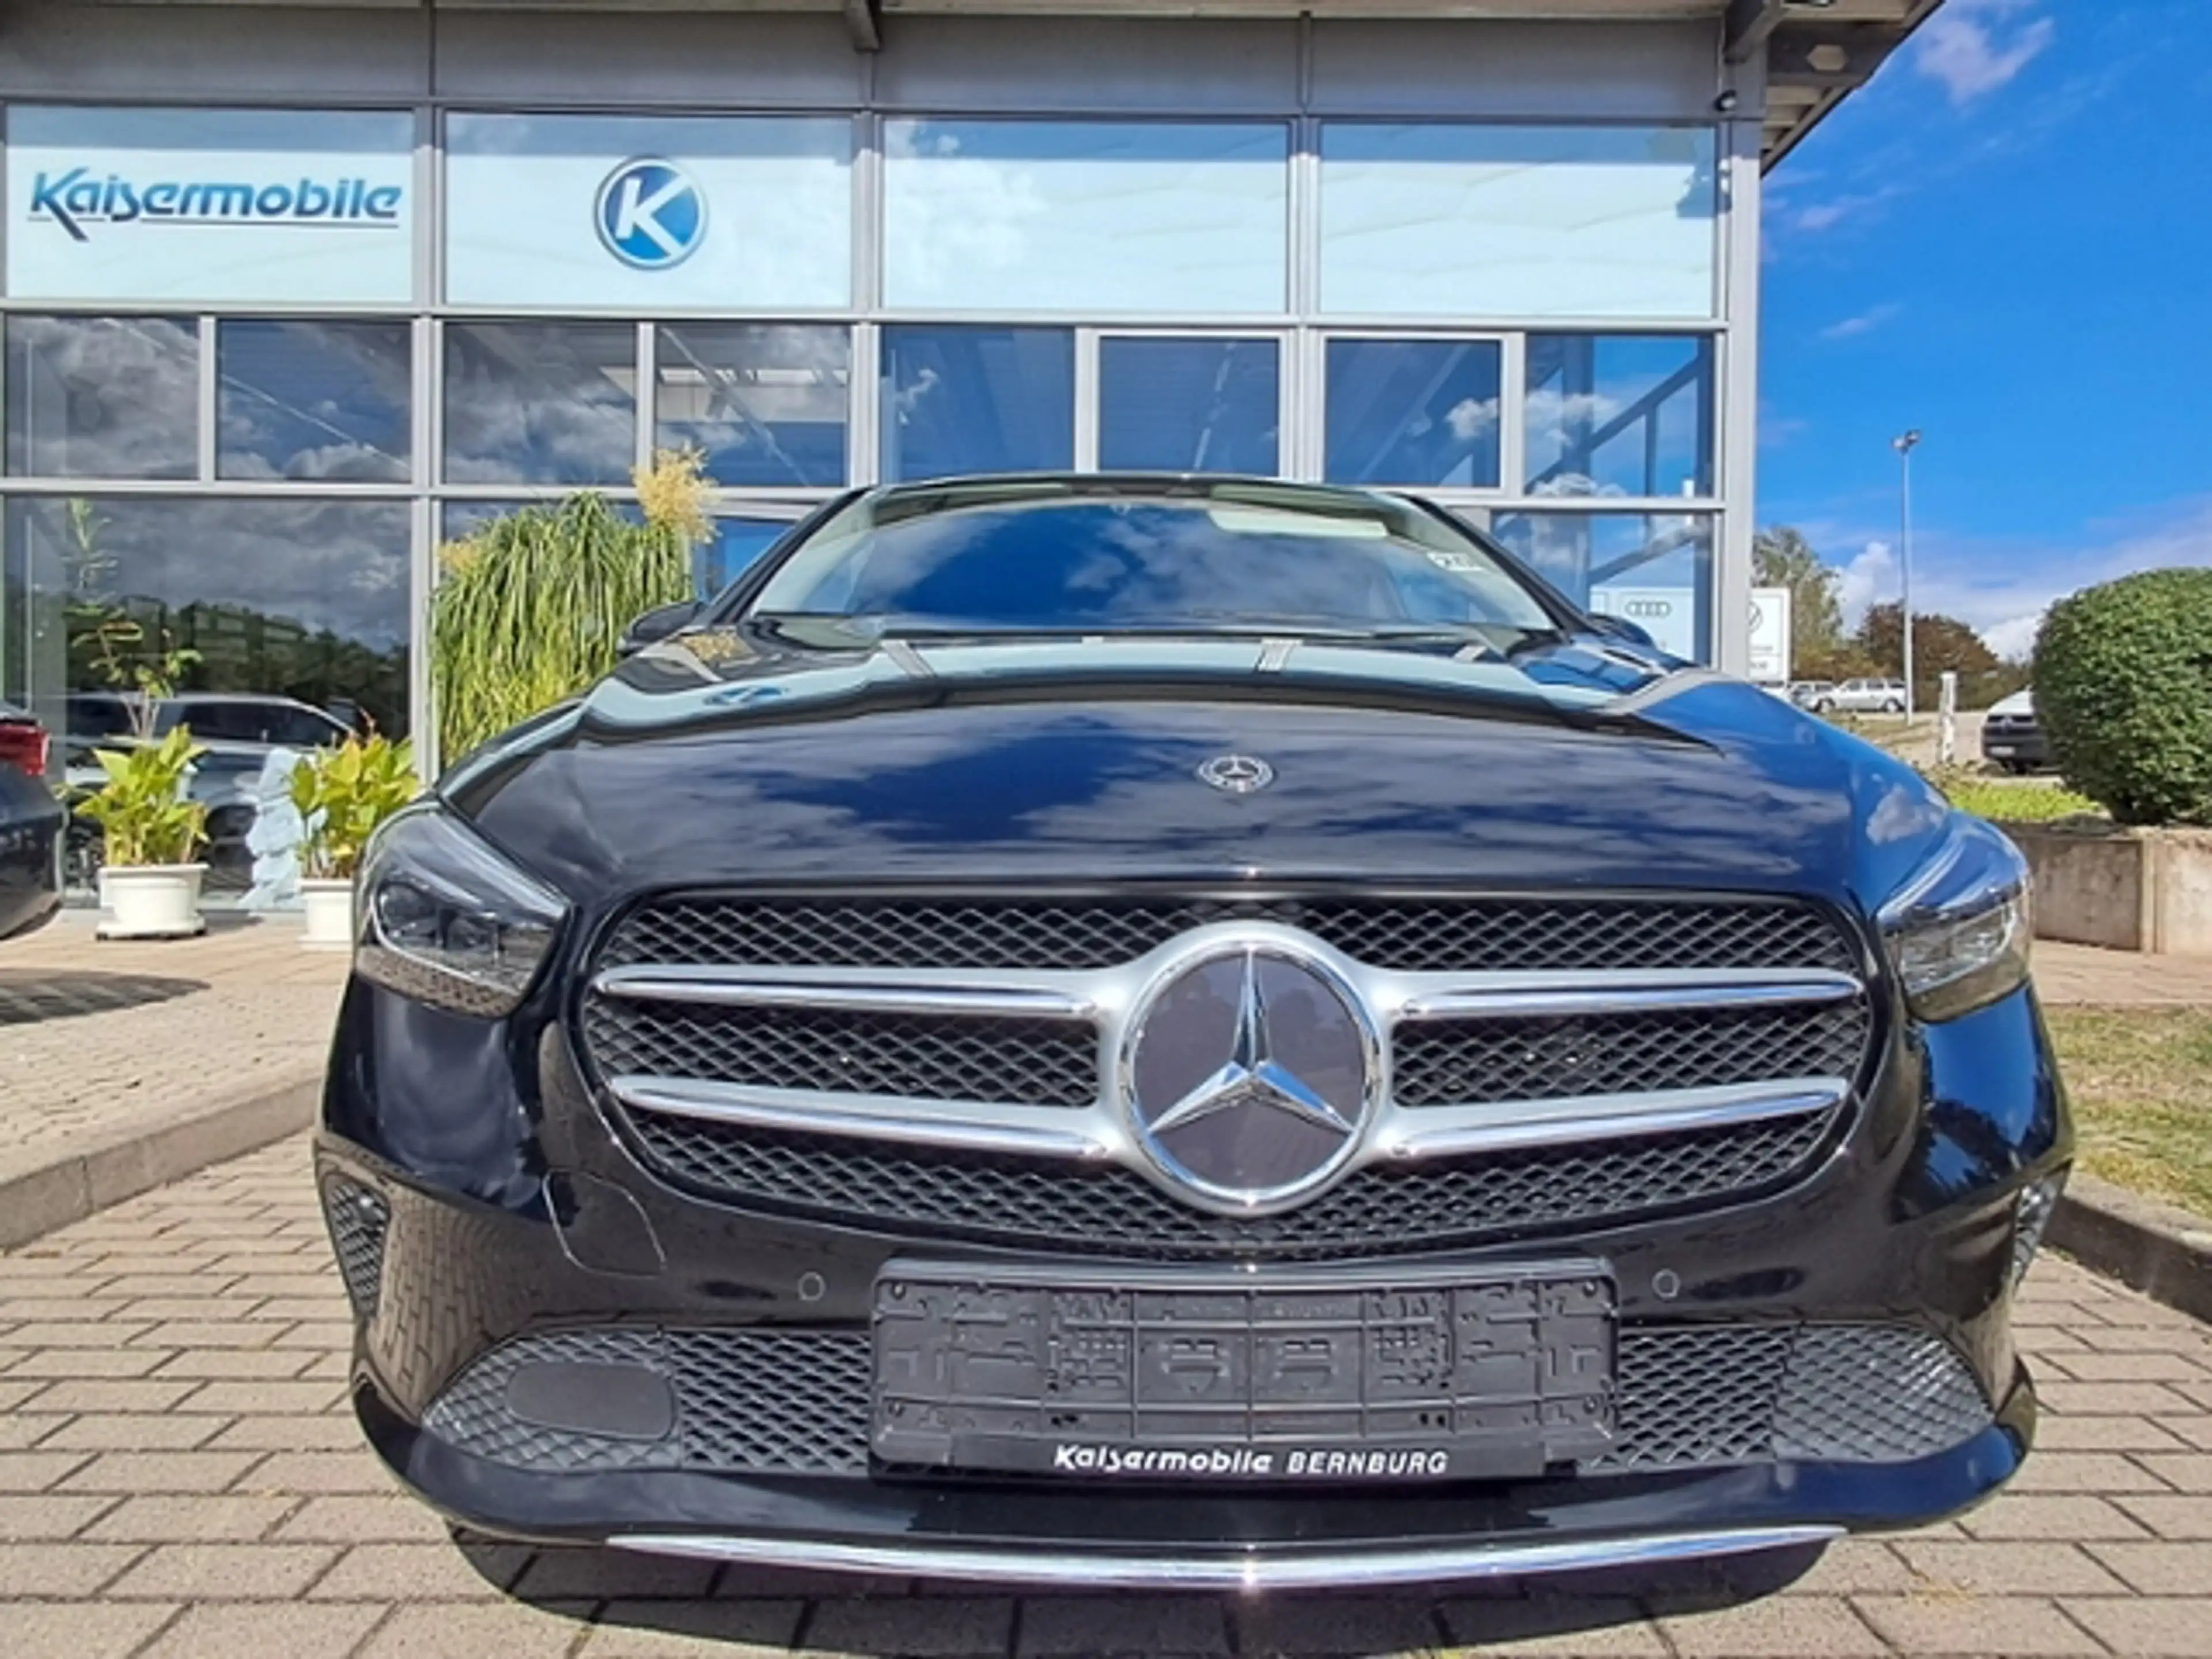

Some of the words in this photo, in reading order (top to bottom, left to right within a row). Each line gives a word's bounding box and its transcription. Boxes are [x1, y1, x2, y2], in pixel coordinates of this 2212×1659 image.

[30, 167, 402, 241] Kaisermobile
[614, 174, 692, 259] K
[1054, 1444, 1272, 1474] Kaisermobile
[1286, 1450, 1449, 1475] BERNBURG
